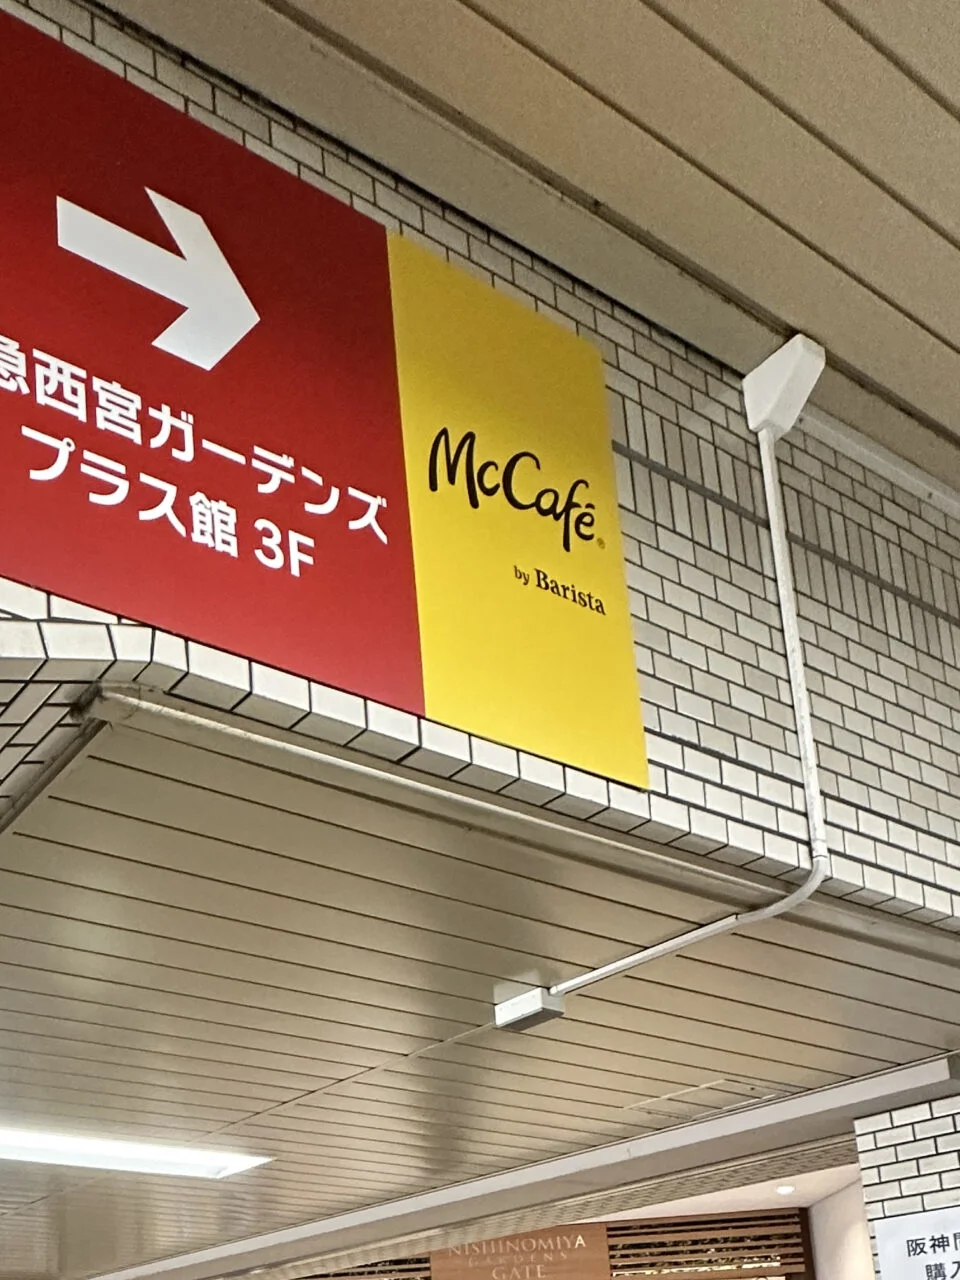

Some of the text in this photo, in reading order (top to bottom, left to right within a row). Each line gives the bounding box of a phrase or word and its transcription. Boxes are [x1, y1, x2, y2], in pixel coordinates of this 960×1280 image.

[21, 425, 315, 578] プラス館 3F
[428, 427, 595, 552] McCafé
[513, 565, 607, 616] by Barista
[491, 1264, 547, 1280] GATE
